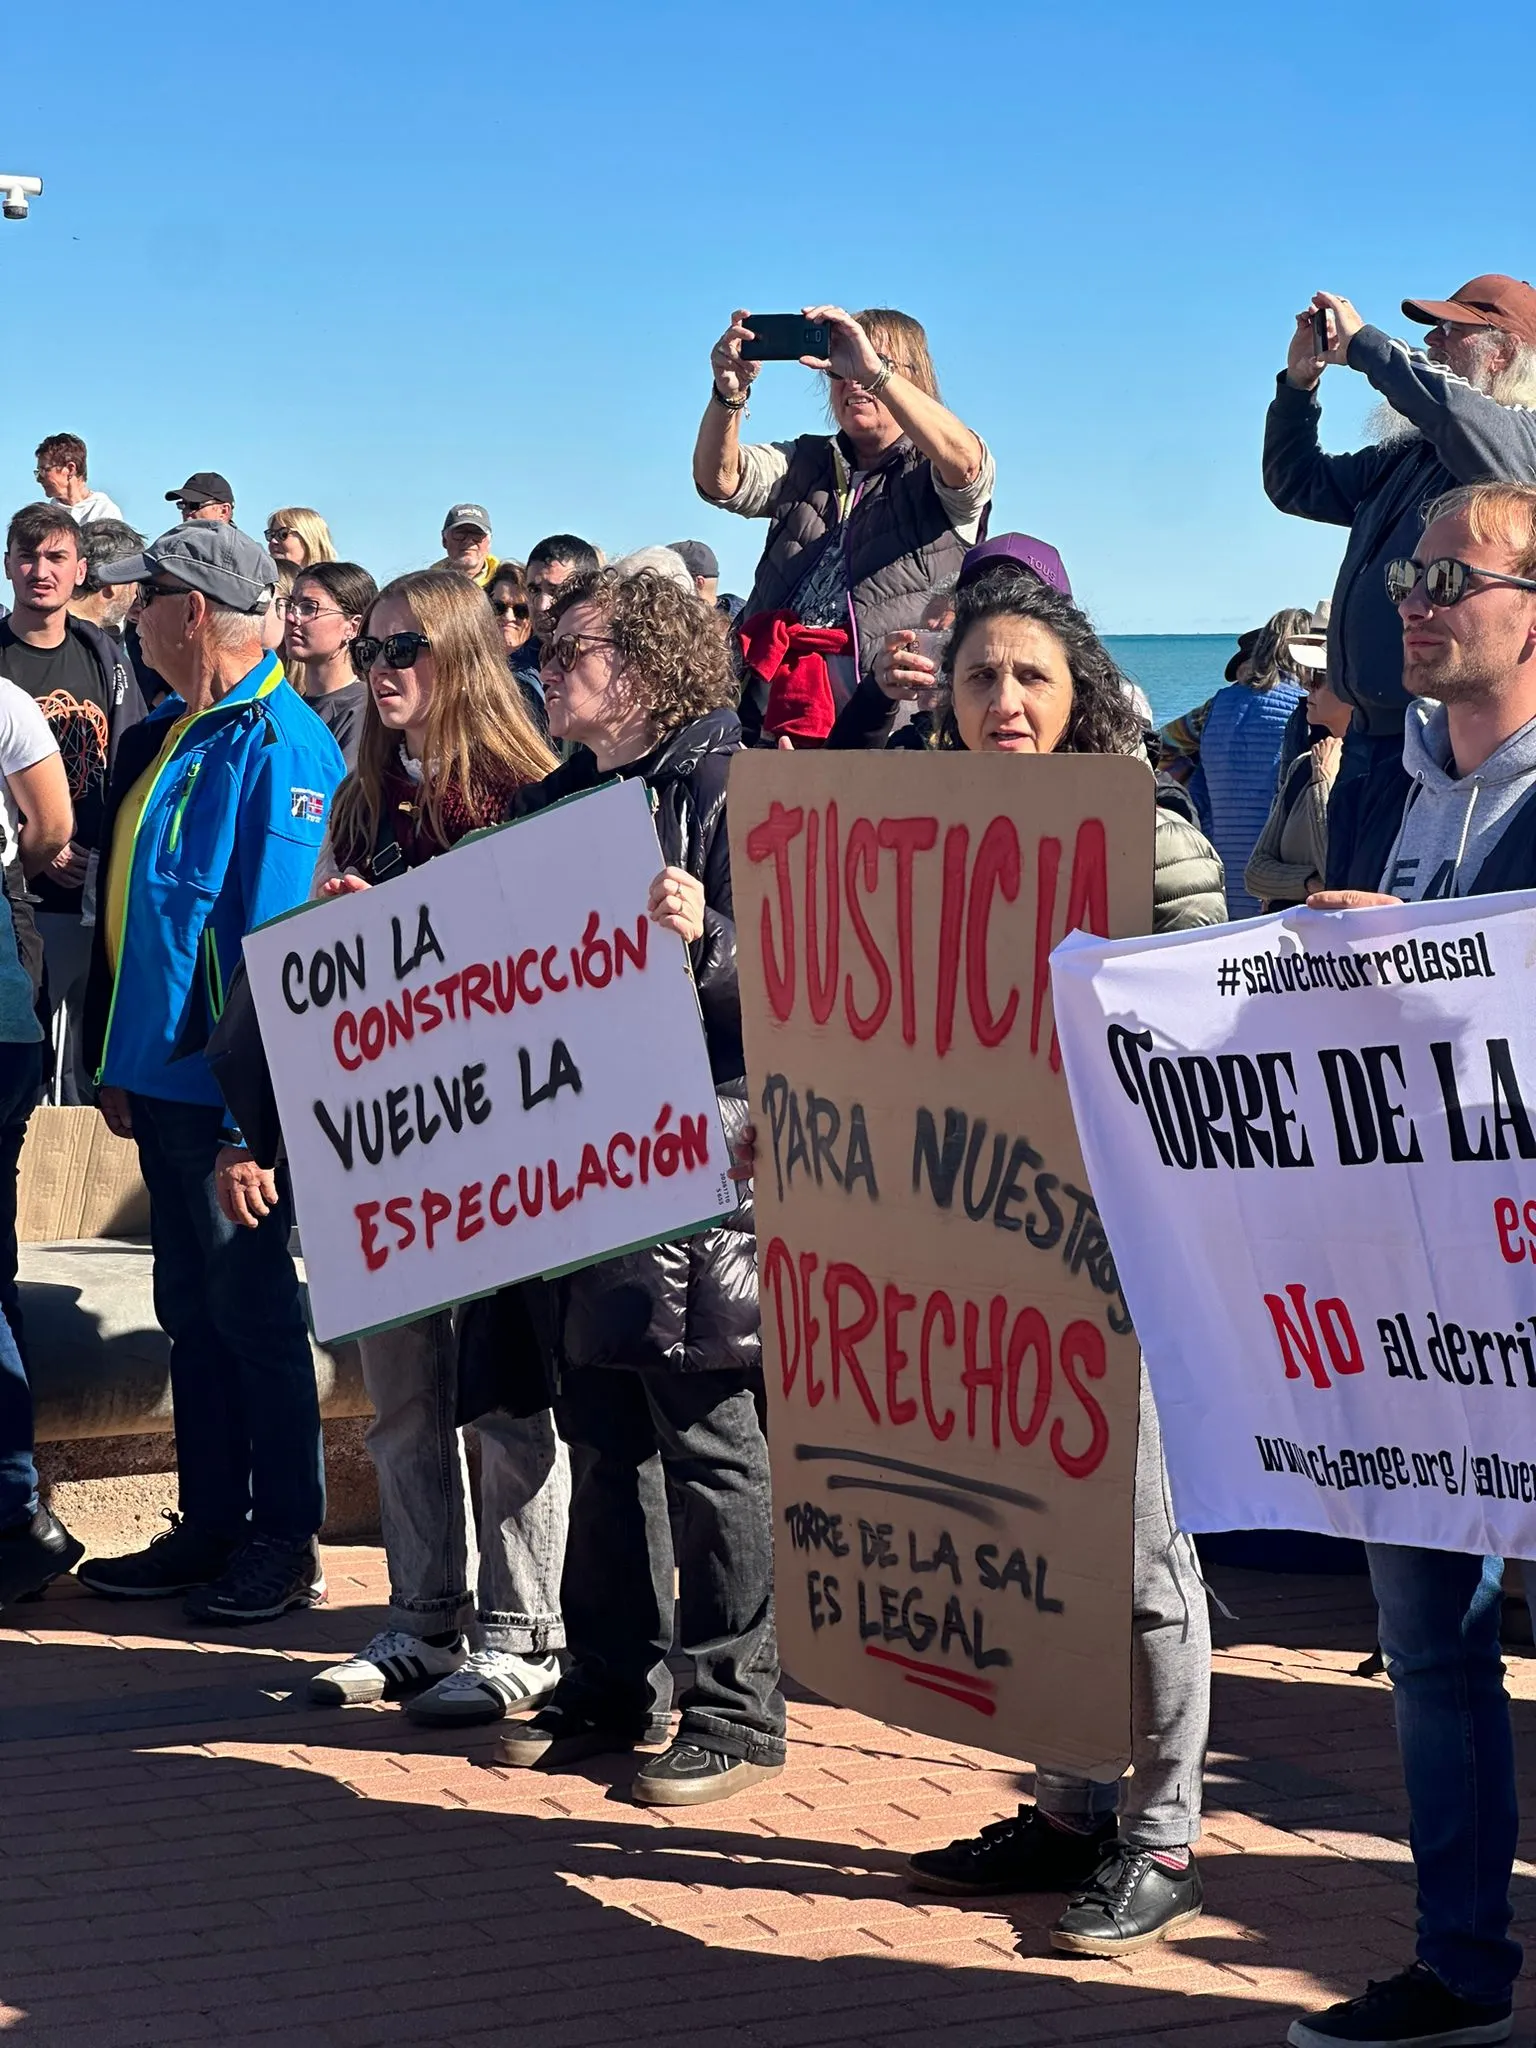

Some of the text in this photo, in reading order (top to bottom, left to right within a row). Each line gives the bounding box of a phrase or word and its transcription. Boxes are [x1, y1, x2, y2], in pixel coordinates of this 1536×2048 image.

[1027, 555, 1057, 583] TOUS
[281, 904, 446, 1015] CON LA
[333, 911, 649, 1071] CONSTRUCCIÓN
[745, 799, 1110, 1075] JUSTICIA
[1217, 931, 1496, 996] #salvemtorrelasal
[313, 1037, 583, 1172] VUELVE LA
[761, 1072, 880, 1203] PARA
[1107, 1023, 1536, 1170] TORRE DE LA
[354, 1103, 710, 1272] ESPECULACIÓN
[762, 1236, 1111, 1481] DERECHOS
[1263, 1283, 1366, 1389] No
[1376, 1312, 1428, 1381] al
[784, 1501, 1065, 1616] TORRE DE LA SAL
[806, 1569, 1014, 1671] ES LEGAL
